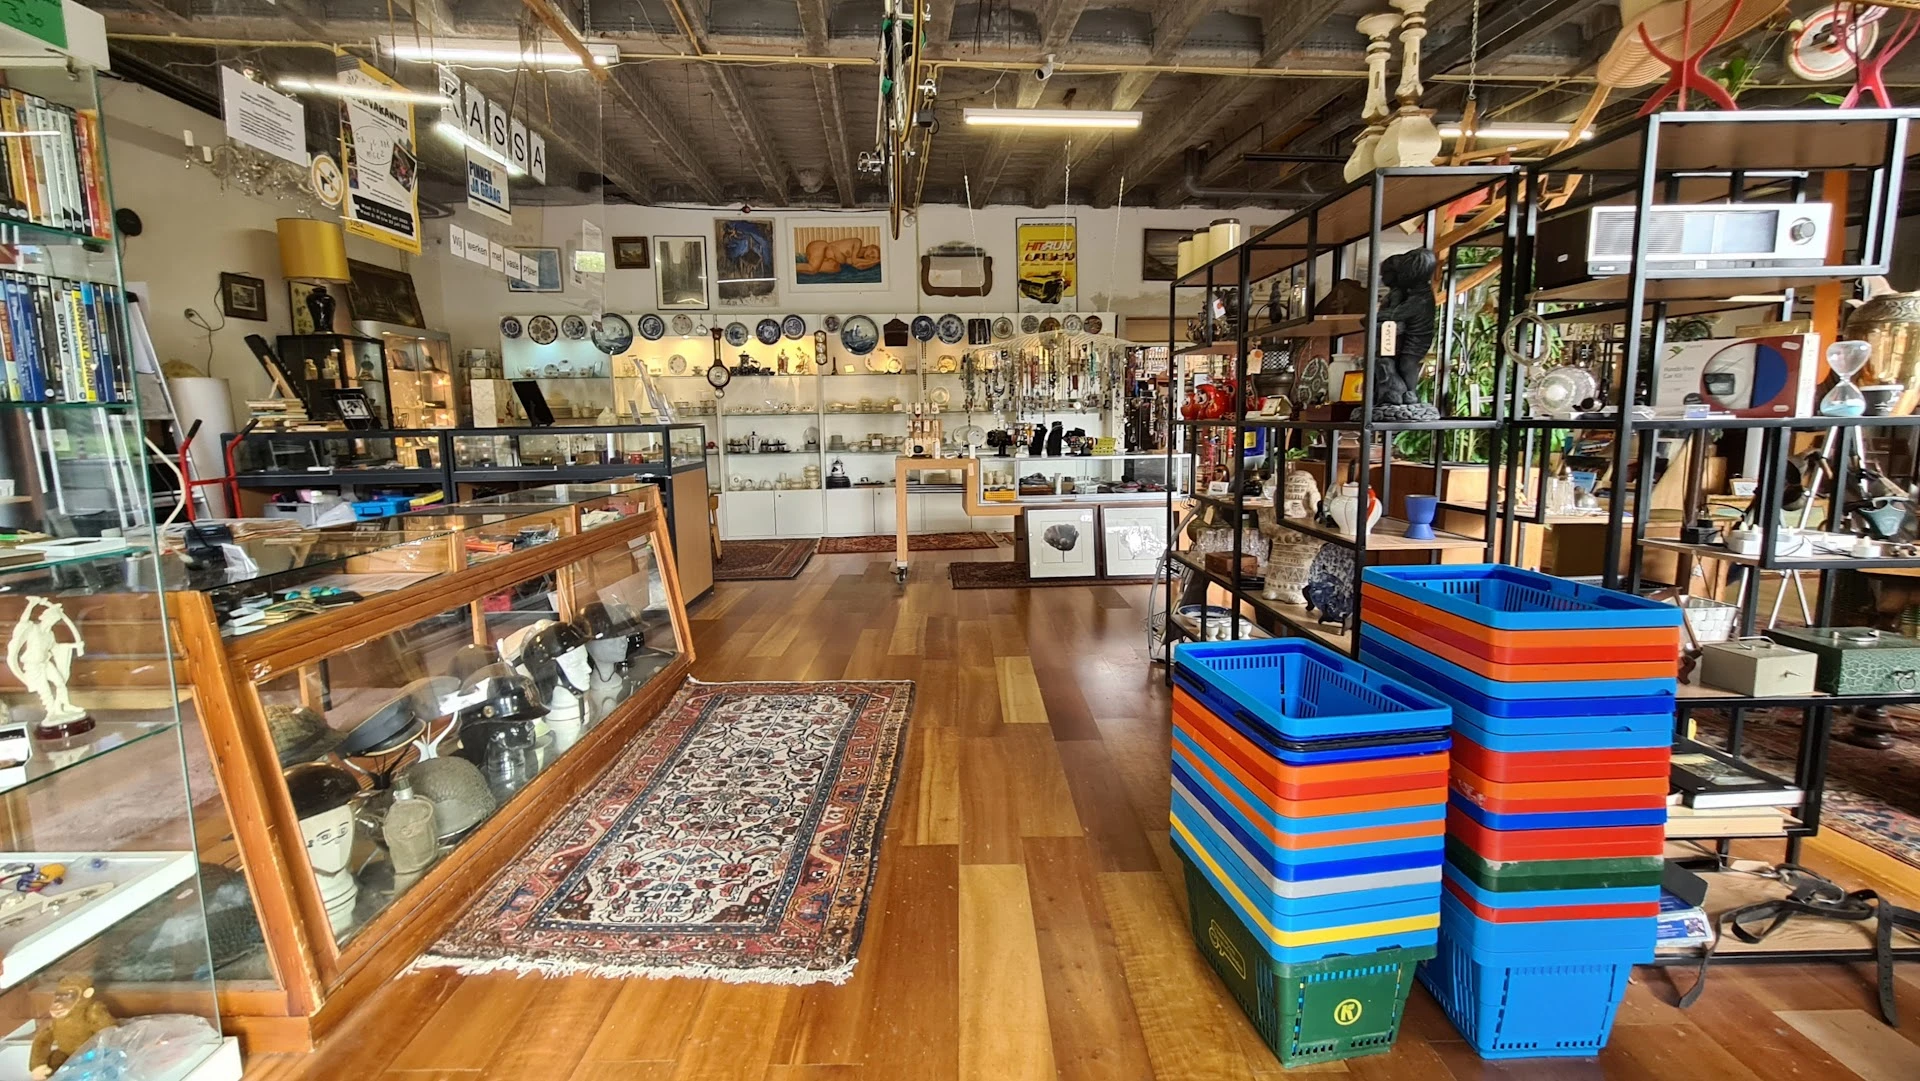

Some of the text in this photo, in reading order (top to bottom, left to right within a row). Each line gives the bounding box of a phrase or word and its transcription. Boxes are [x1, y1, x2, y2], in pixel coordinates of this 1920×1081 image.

[444, 81, 544, 173] KASSA
[469, 160, 492, 186] PINNEN
[470, 177, 502, 204] JA GRAAG
[452, 234, 462, 250] Wij
[467, 239, 488, 257] werken
[491, 249, 502, 262] met
[58, 313, 69, 354] OUTCAST
[75, 297, 95, 391] MONOPOLY JUNIOR
[1339, 1002, 1356, 1022] K
